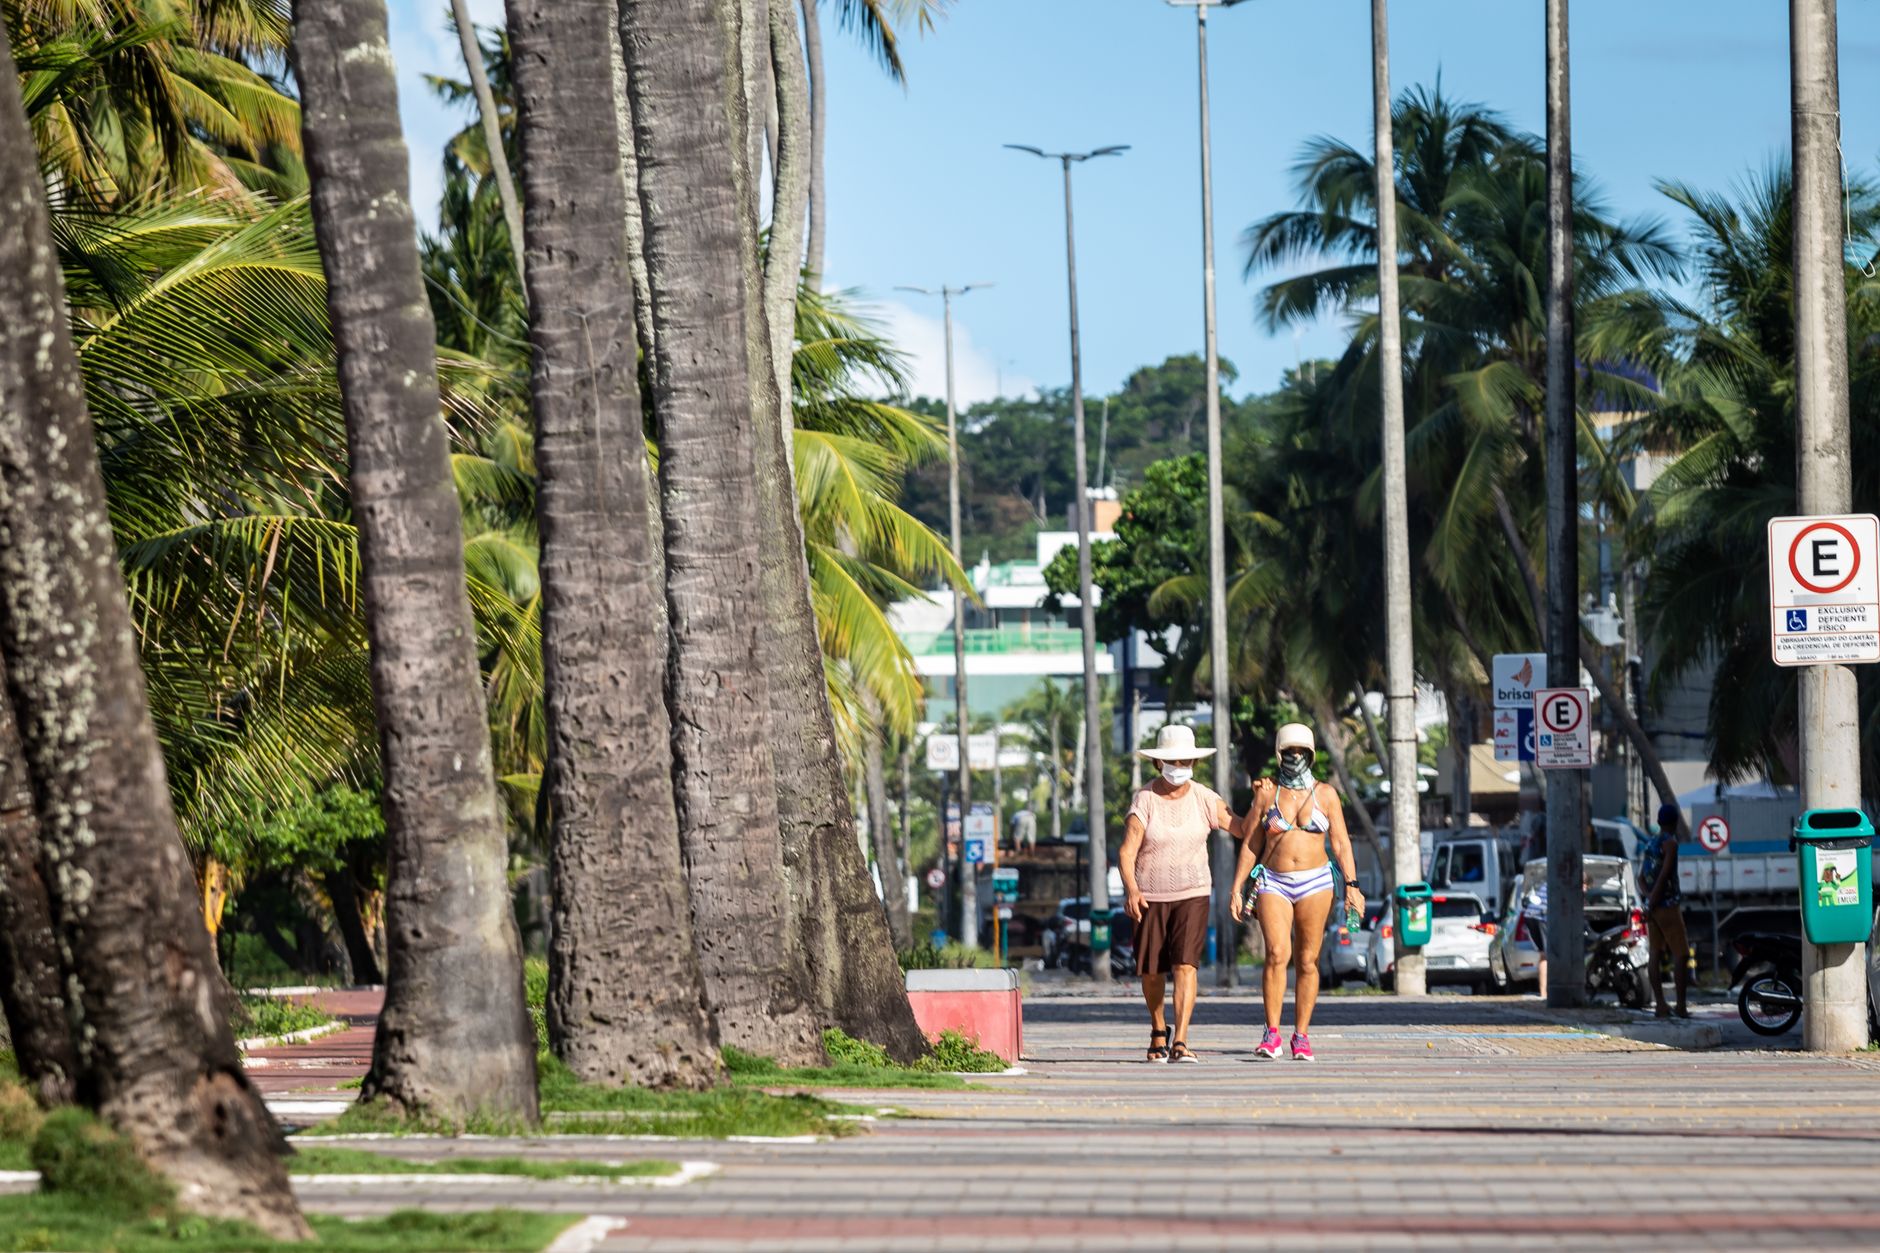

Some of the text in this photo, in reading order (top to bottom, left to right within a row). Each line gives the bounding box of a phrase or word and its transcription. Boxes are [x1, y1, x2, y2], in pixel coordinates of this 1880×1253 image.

[1812, 540, 1840, 576] E
[1818, 606, 1866, 614] EXCLUSIVO
[1818, 615, 1867, 623] DEFICIENTE
[1556, 701, 1570, 725] E
